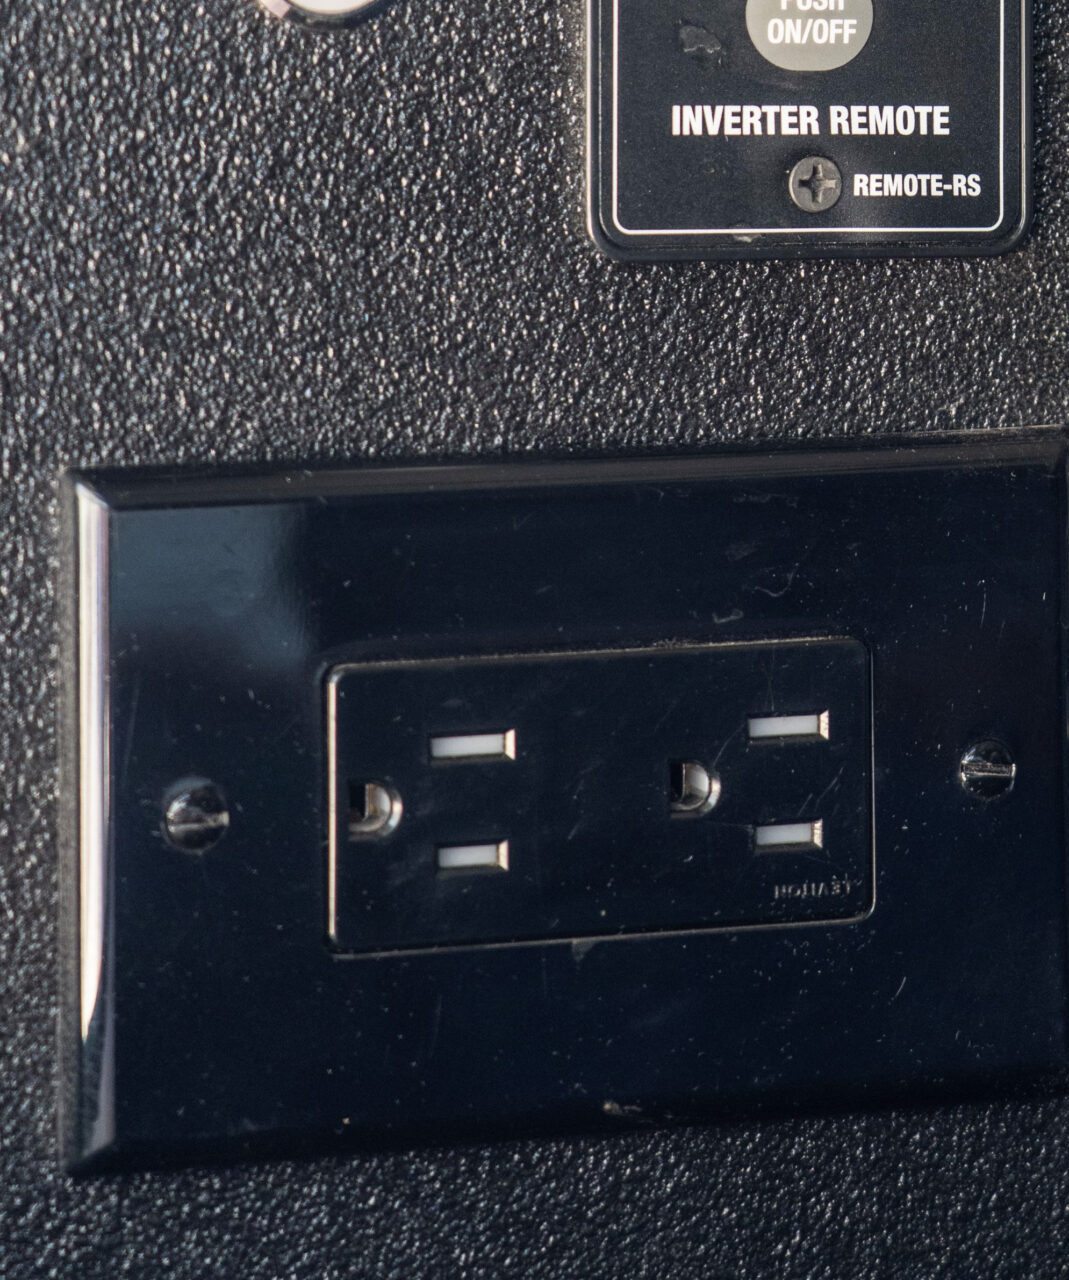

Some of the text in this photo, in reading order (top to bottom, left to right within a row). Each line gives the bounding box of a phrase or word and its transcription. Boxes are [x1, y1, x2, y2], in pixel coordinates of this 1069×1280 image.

[767, 19, 857, 44] ON/OFF
[671, 105, 950, 136] INVERTER REMOTE
[853, 174, 981, 197] REMOTE-RS
